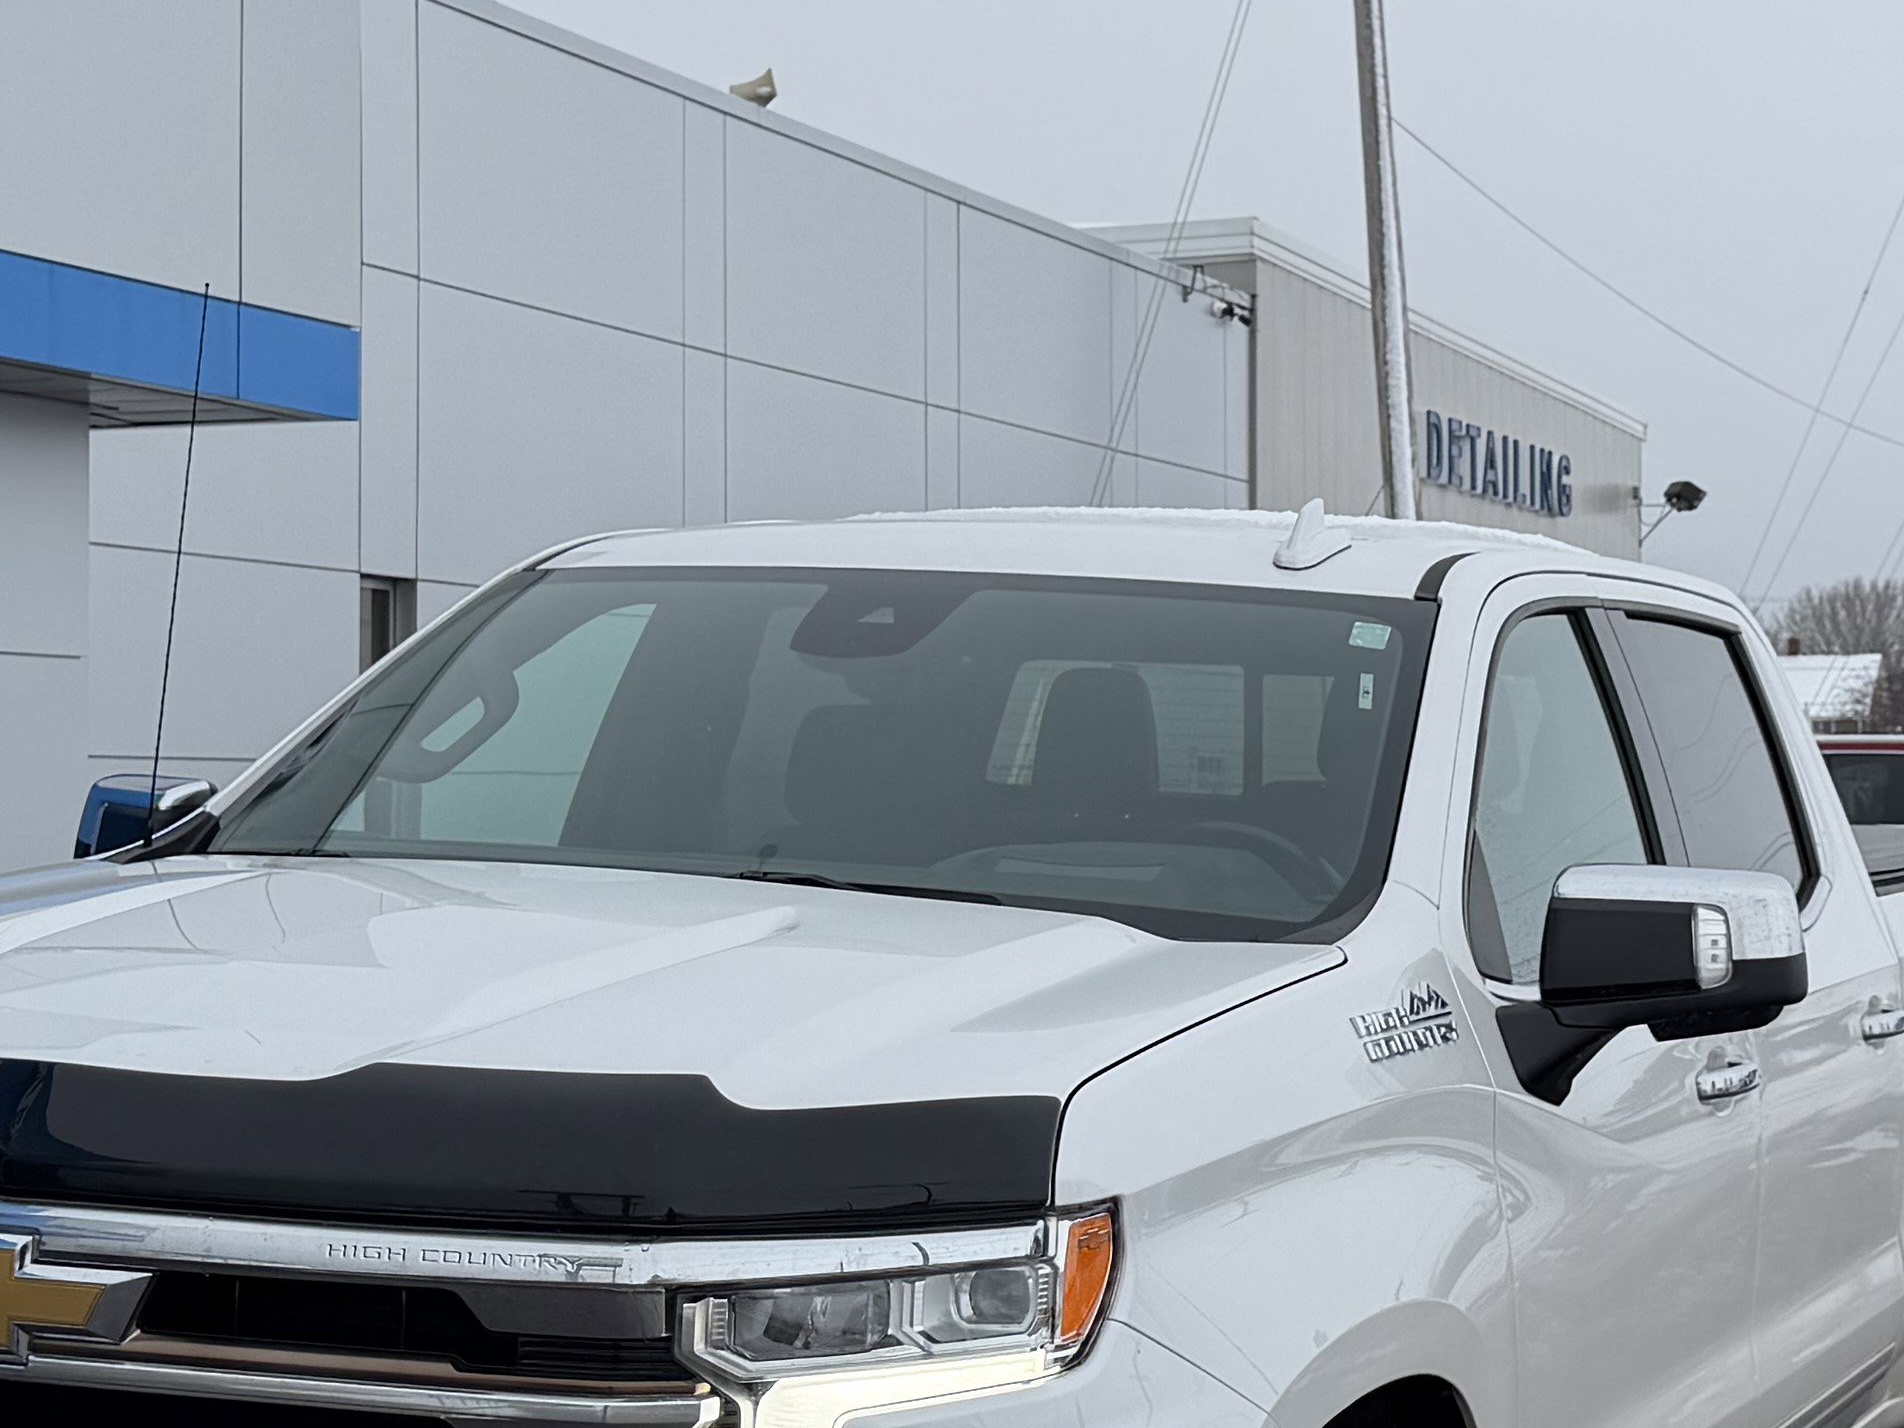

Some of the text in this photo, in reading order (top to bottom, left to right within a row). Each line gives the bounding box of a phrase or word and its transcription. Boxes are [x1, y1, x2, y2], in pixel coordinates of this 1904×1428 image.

[1426, 409, 1573, 517] DETAILING
[327, 1243, 584, 1273] HIGH COUNTRY
